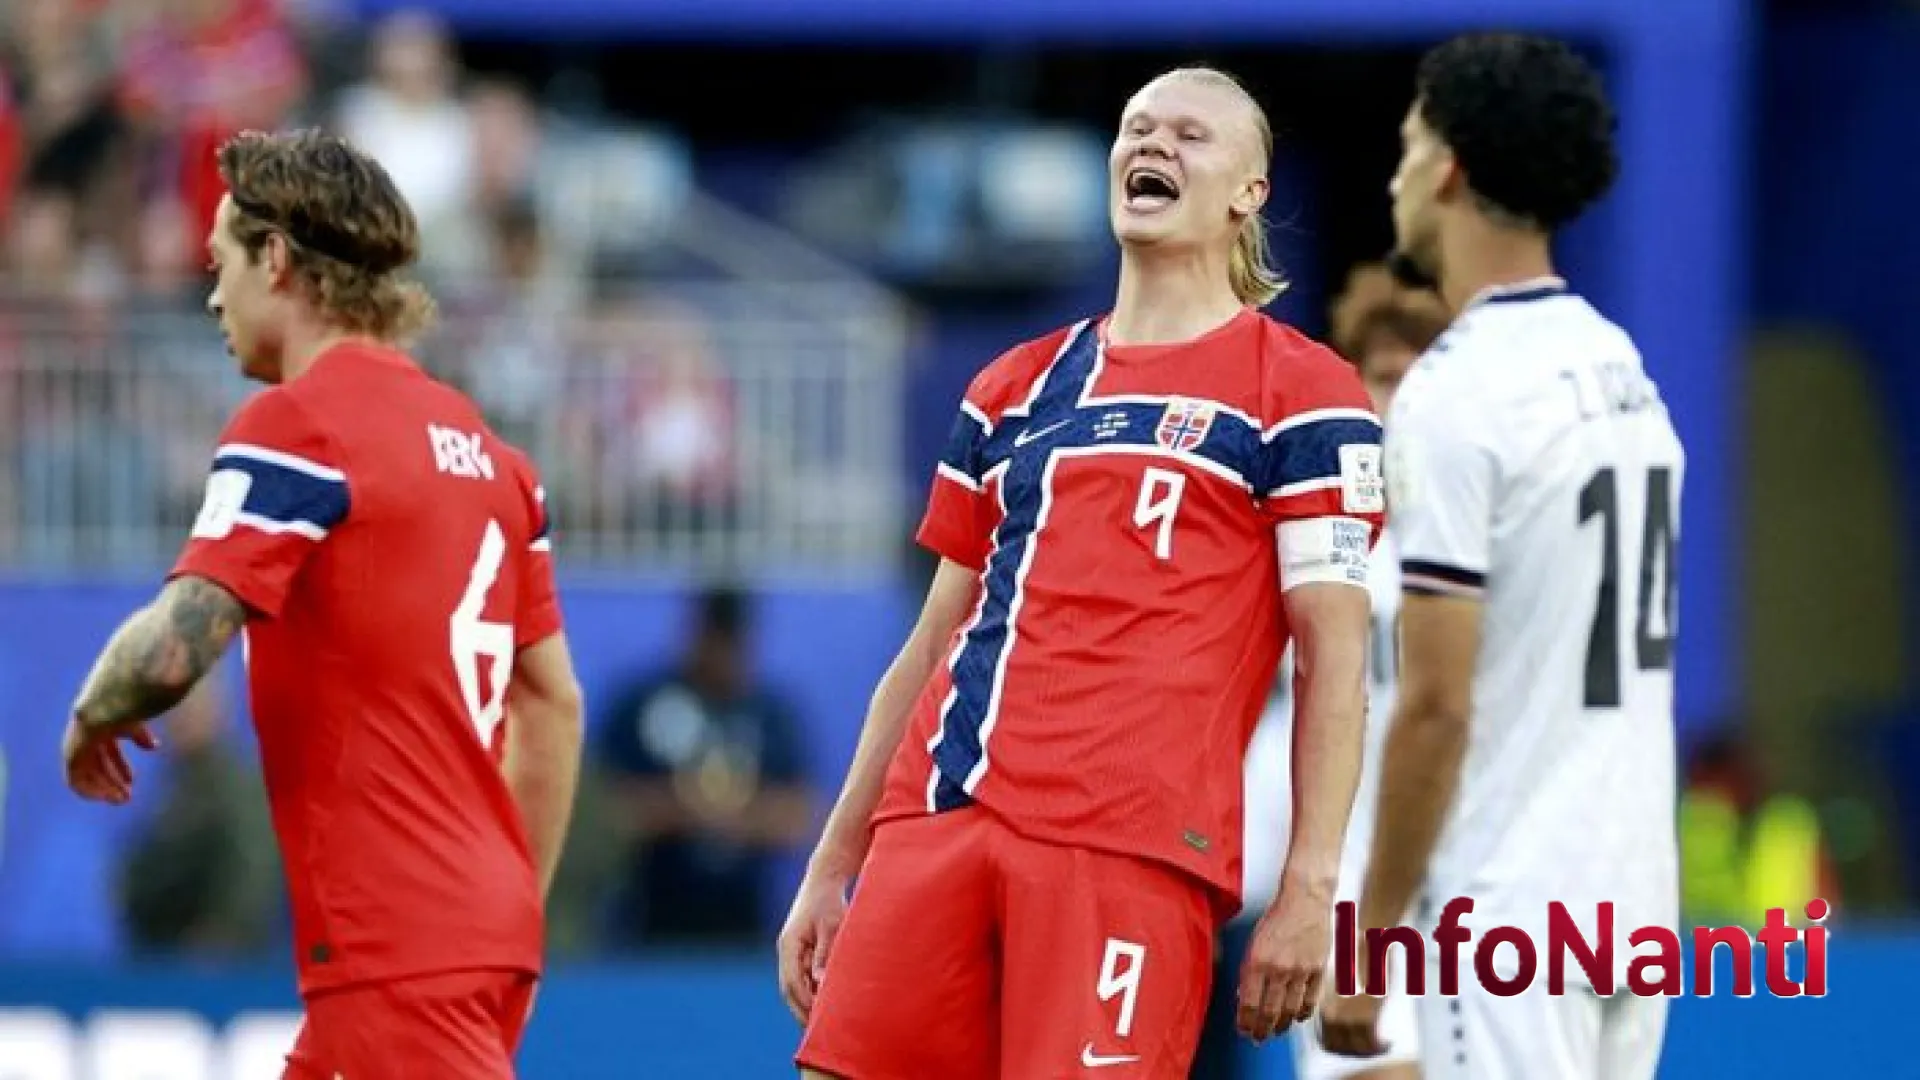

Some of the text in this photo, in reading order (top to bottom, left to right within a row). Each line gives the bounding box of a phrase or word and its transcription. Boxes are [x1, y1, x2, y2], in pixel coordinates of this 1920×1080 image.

[1133, 466, 1186, 559] 9
[1578, 466, 1677, 708] 14
[451, 517, 515, 750] 6
[1097, 937, 1146, 1036] 9
